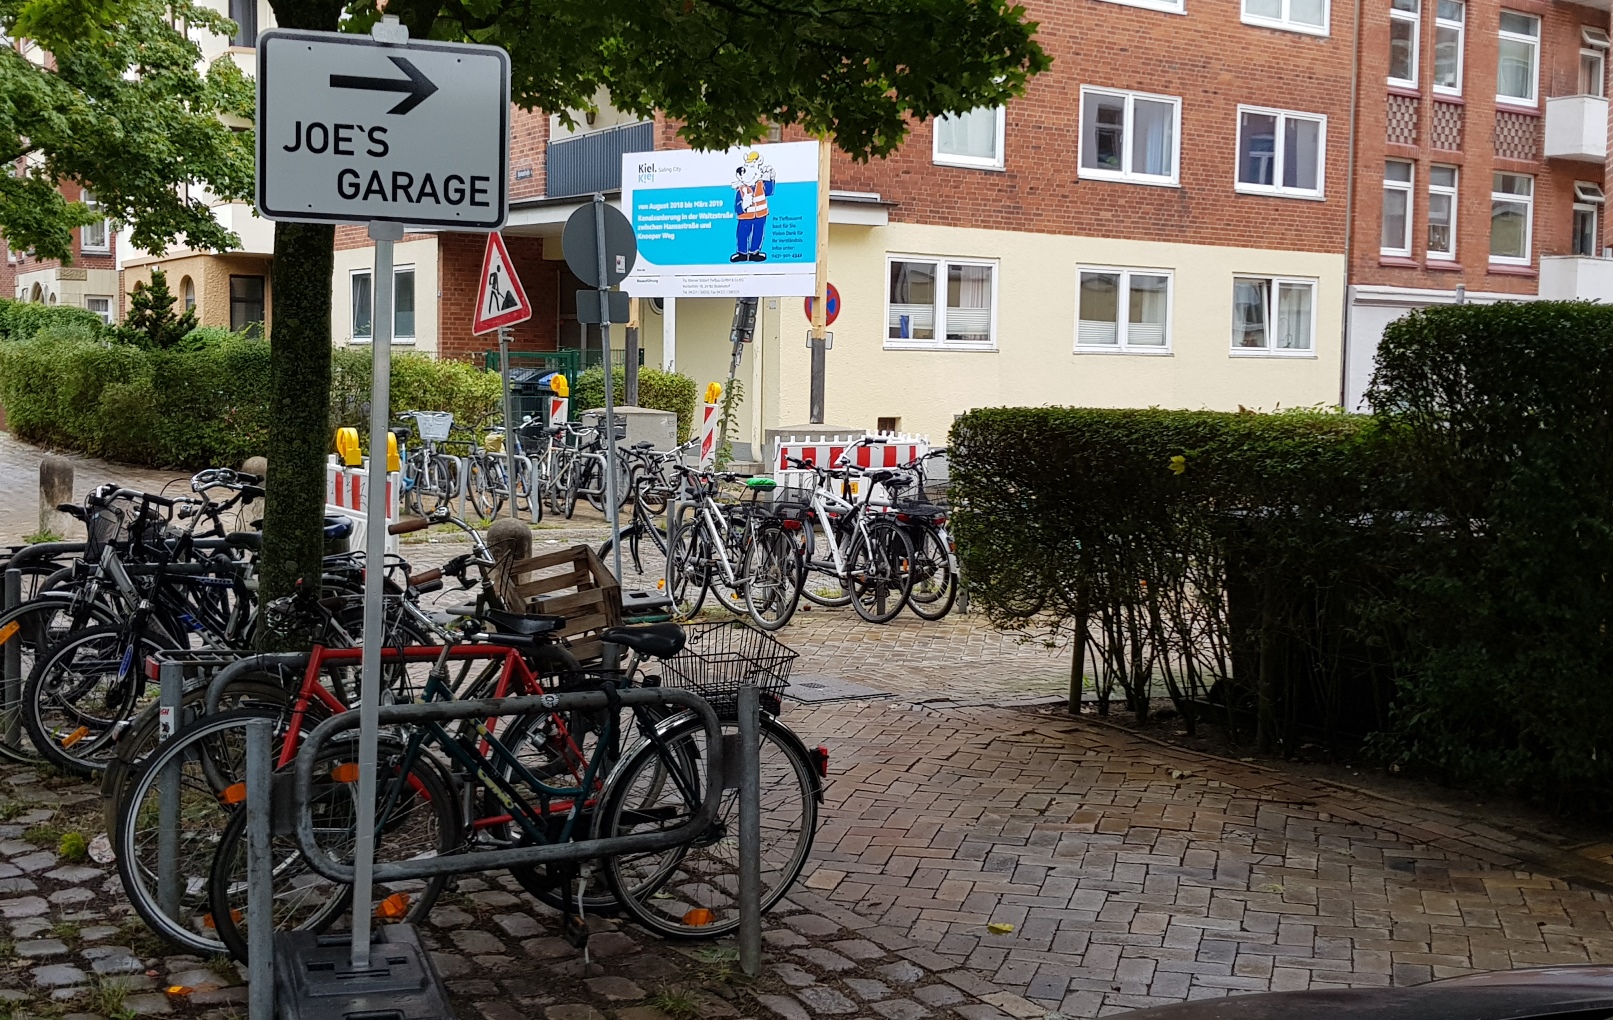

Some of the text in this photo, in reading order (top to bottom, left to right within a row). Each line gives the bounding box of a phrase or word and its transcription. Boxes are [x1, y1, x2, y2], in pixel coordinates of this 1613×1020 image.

[337, 168, 491, 208] GARAGE
[649, 203, 669, 211] August
[670, 201, 684, 209] 2018
[694, 200, 708, 208] März
[709, 199, 723, 207] 2019
[638, 213, 681, 222] Kanalsanierung
[682, 212, 688, 220] in
[661, 232, 675, 240] Weg
